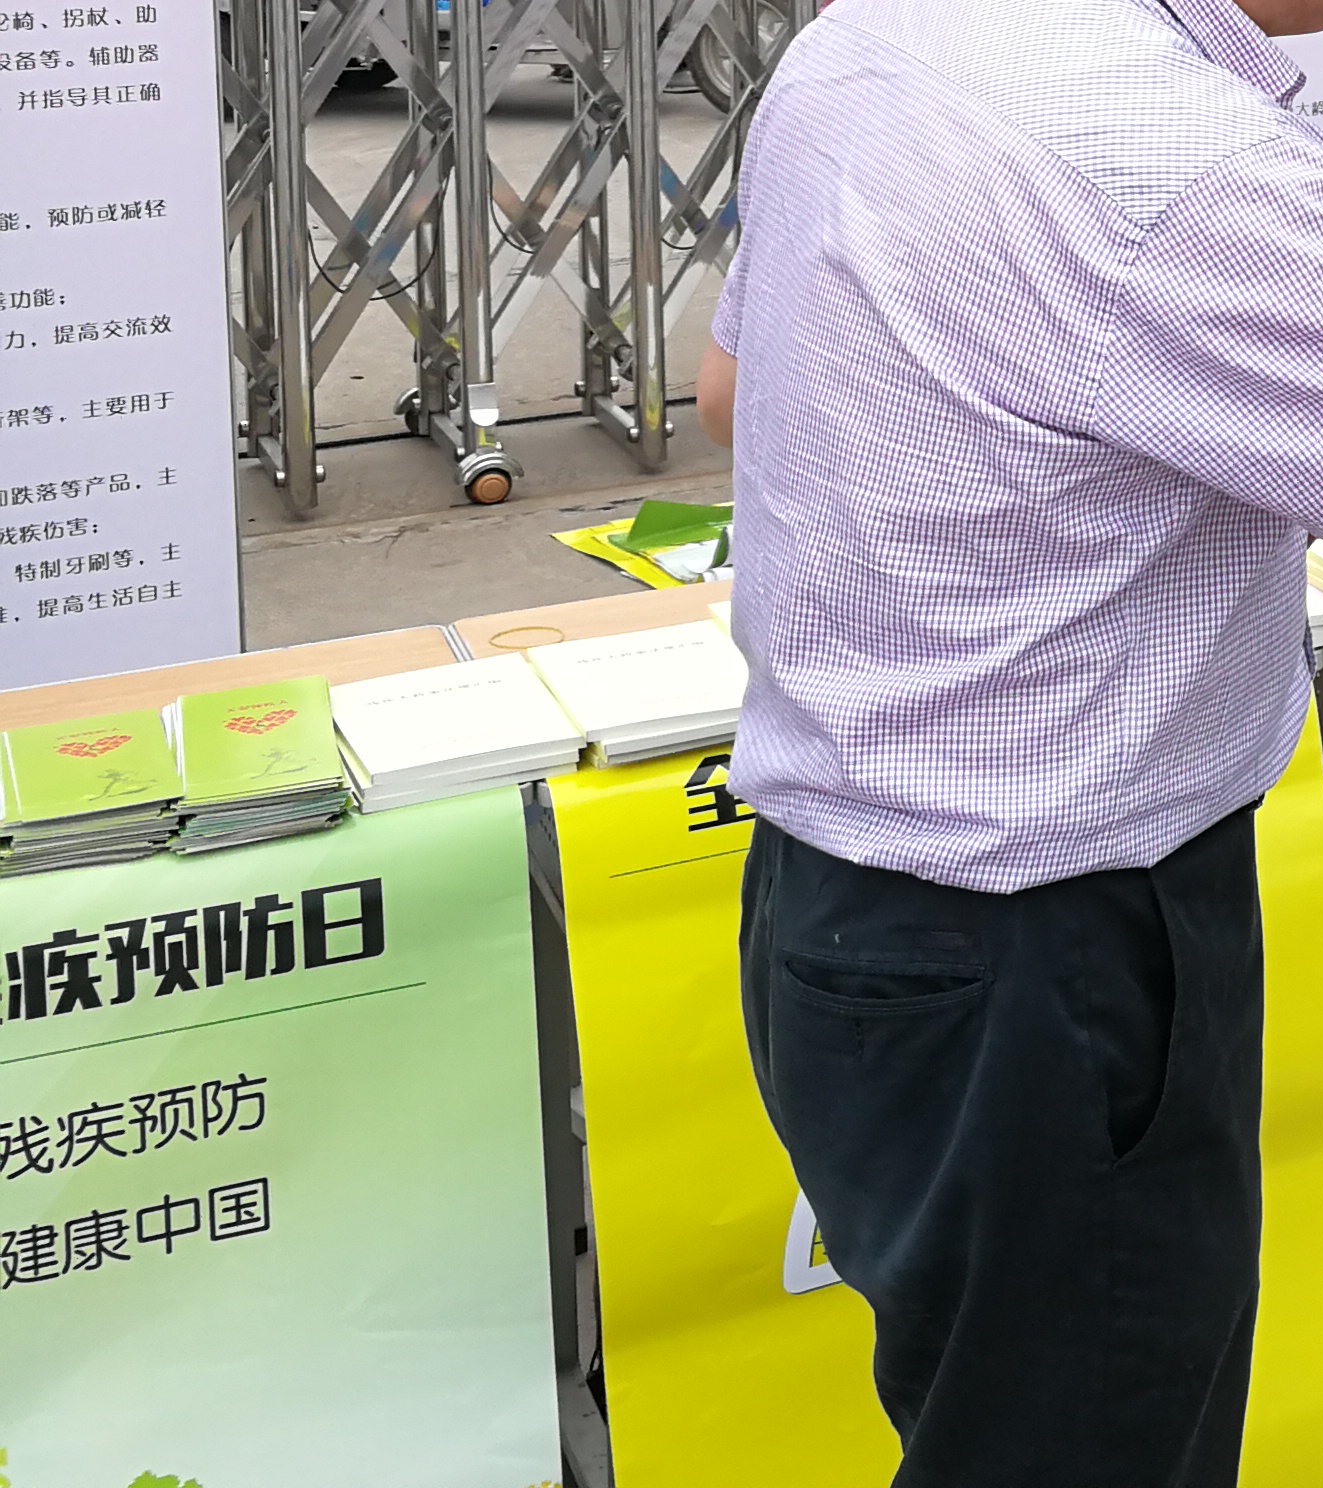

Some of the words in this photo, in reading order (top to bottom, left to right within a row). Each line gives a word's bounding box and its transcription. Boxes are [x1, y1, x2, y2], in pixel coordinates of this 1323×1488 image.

[18, 83, 161, 111] 并指导其正确
[0, 391, 175, 429] 架等，主要用于
[0, 877, 385, 1025] 疾预防日
[0, 1071, 269, 1180] 残疾预防
